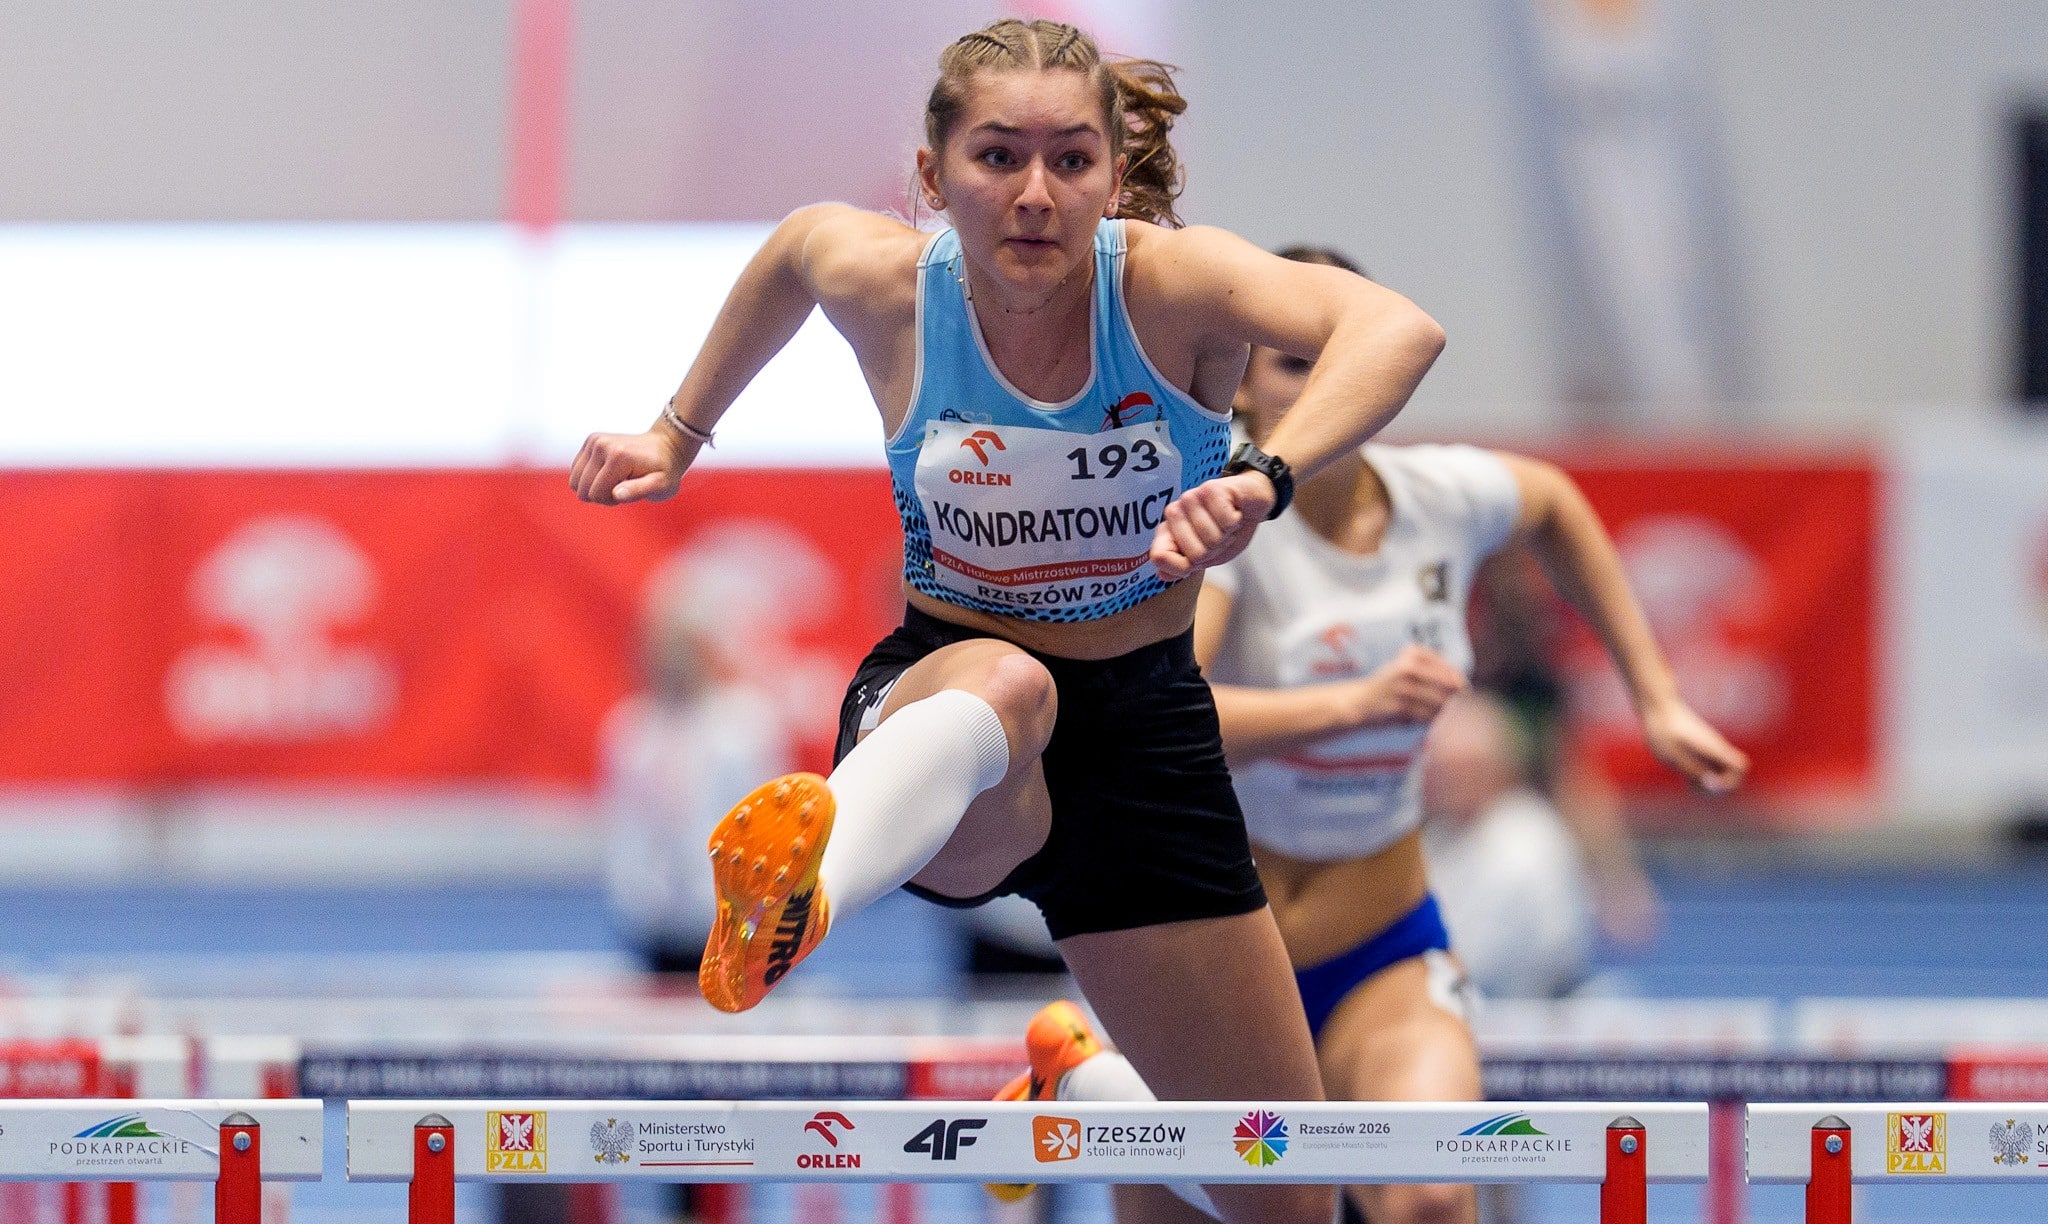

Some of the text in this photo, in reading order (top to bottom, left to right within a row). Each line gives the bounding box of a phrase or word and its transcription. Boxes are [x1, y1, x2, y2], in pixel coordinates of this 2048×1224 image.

[1067, 439, 1160, 480] 193
[949, 469, 1011, 486] ORLEN
[933, 487, 1174, 547] KONDRATOWICZ
[940, 554, 965, 571] PZLA
[966, 567, 1010, 583] Halowe
[1013, 565, 1088, 582] Mistrzostwa
[1091, 561, 1127, 573] Polski
[977, 571, 1140, 605] RZESZÓW 2026
[638, 1122, 726, 1135] Ministerstwo
[1086, 1123, 1186, 1143] rzeszów
[1299, 1122, 1391, 1135] Rzeszów 2026
[638, 1139, 683, 1153] Sportu
[694, 1138, 755, 1153] Turystyki
[903, 1118, 988, 1161] 4F
[1435, 1139, 1573, 1153] PODKARPACKIE
[50, 1141, 189, 1155] PODKARPACKIE
[1086, 1145, 1186, 1160] stolica innowacji
[127, 1157, 163, 1165] otwarta
[489, 1152, 543, 1170] PZLA
[796, 1154, 861, 1169] ORLEN
[1511, 1154, 1546, 1163] otwarta
[1889, 1154, 1943, 1171] PZLA
